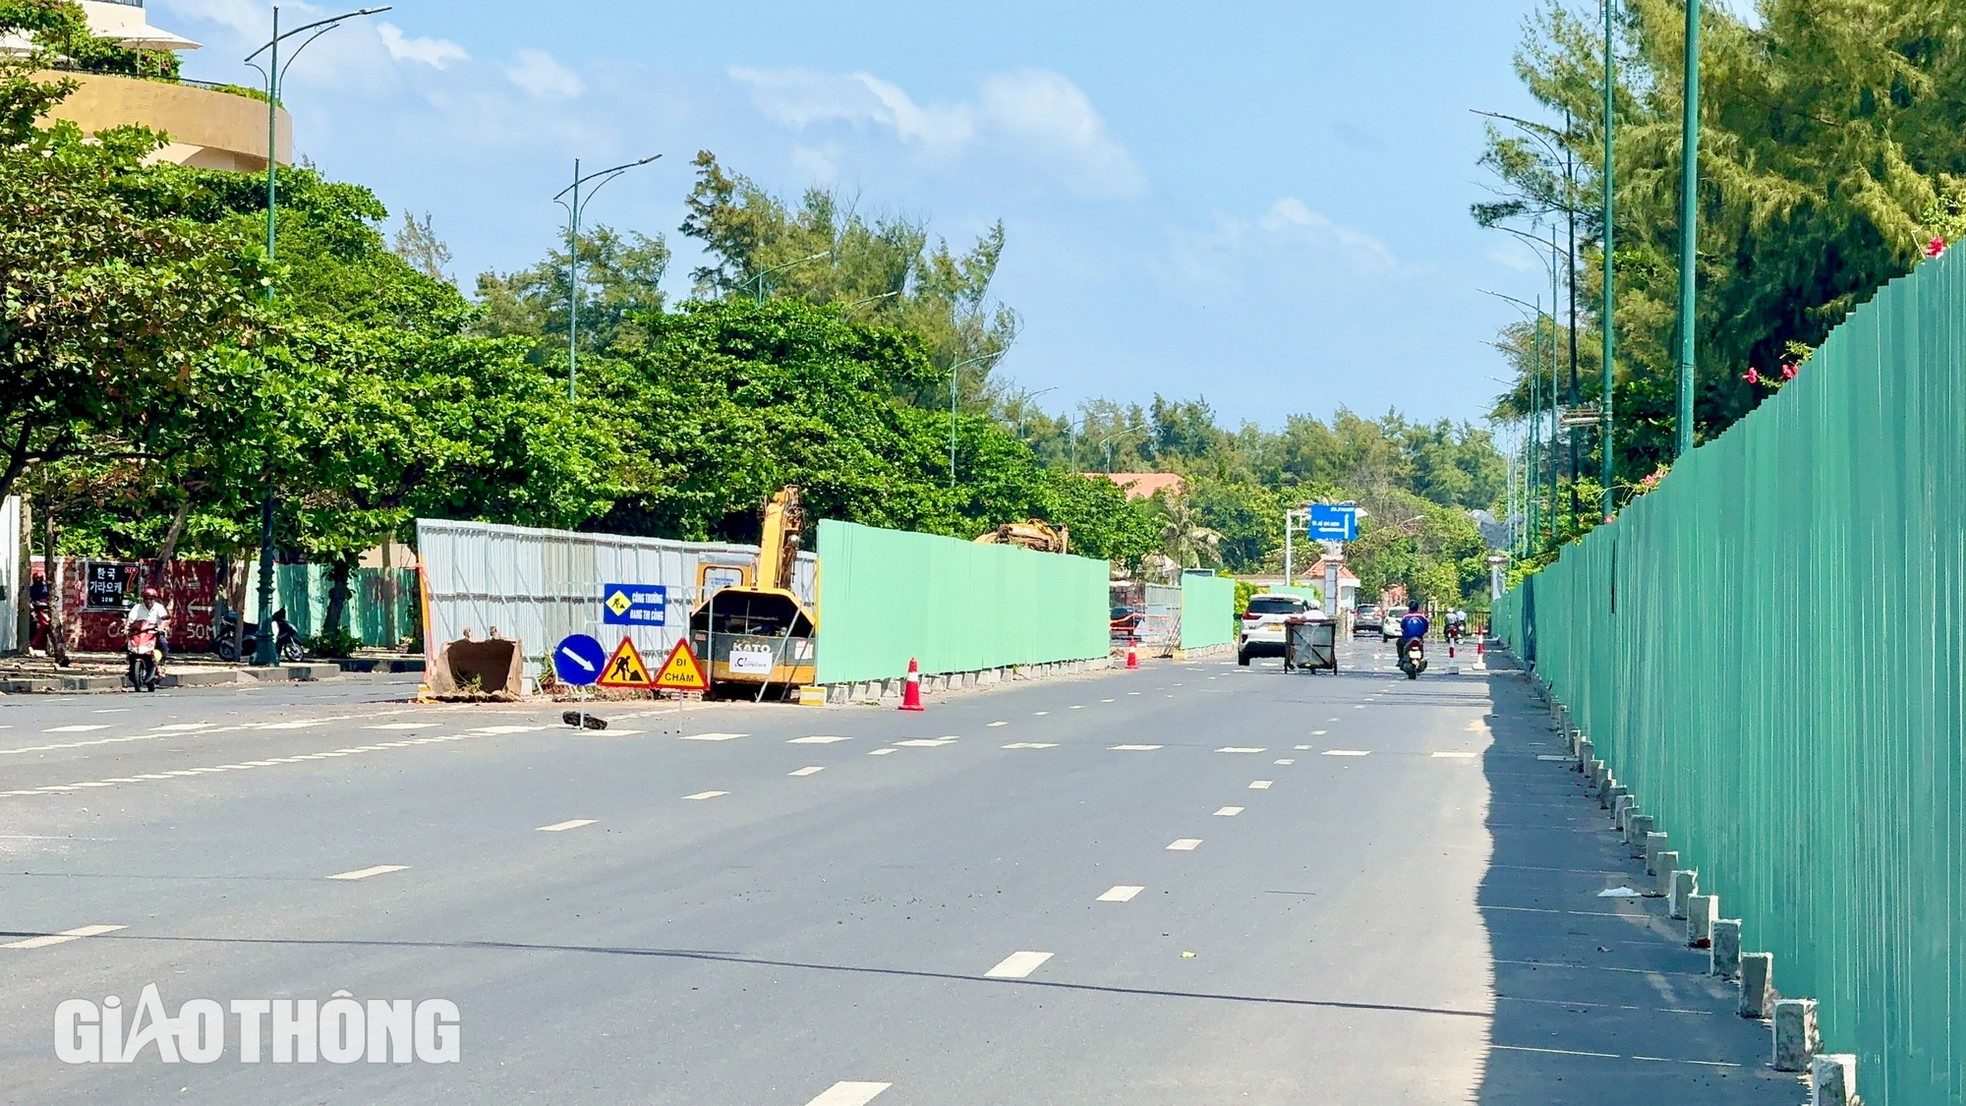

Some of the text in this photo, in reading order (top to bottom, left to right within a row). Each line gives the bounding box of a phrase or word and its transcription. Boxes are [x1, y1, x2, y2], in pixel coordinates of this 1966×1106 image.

[97, 567, 116, 580] 한국
[90, 581, 122, 594] 가라오케
[733, 642, 771, 653] KATO
[676, 658, 686, 666] ĐI
[664, 672, 694, 683] CHẬM
